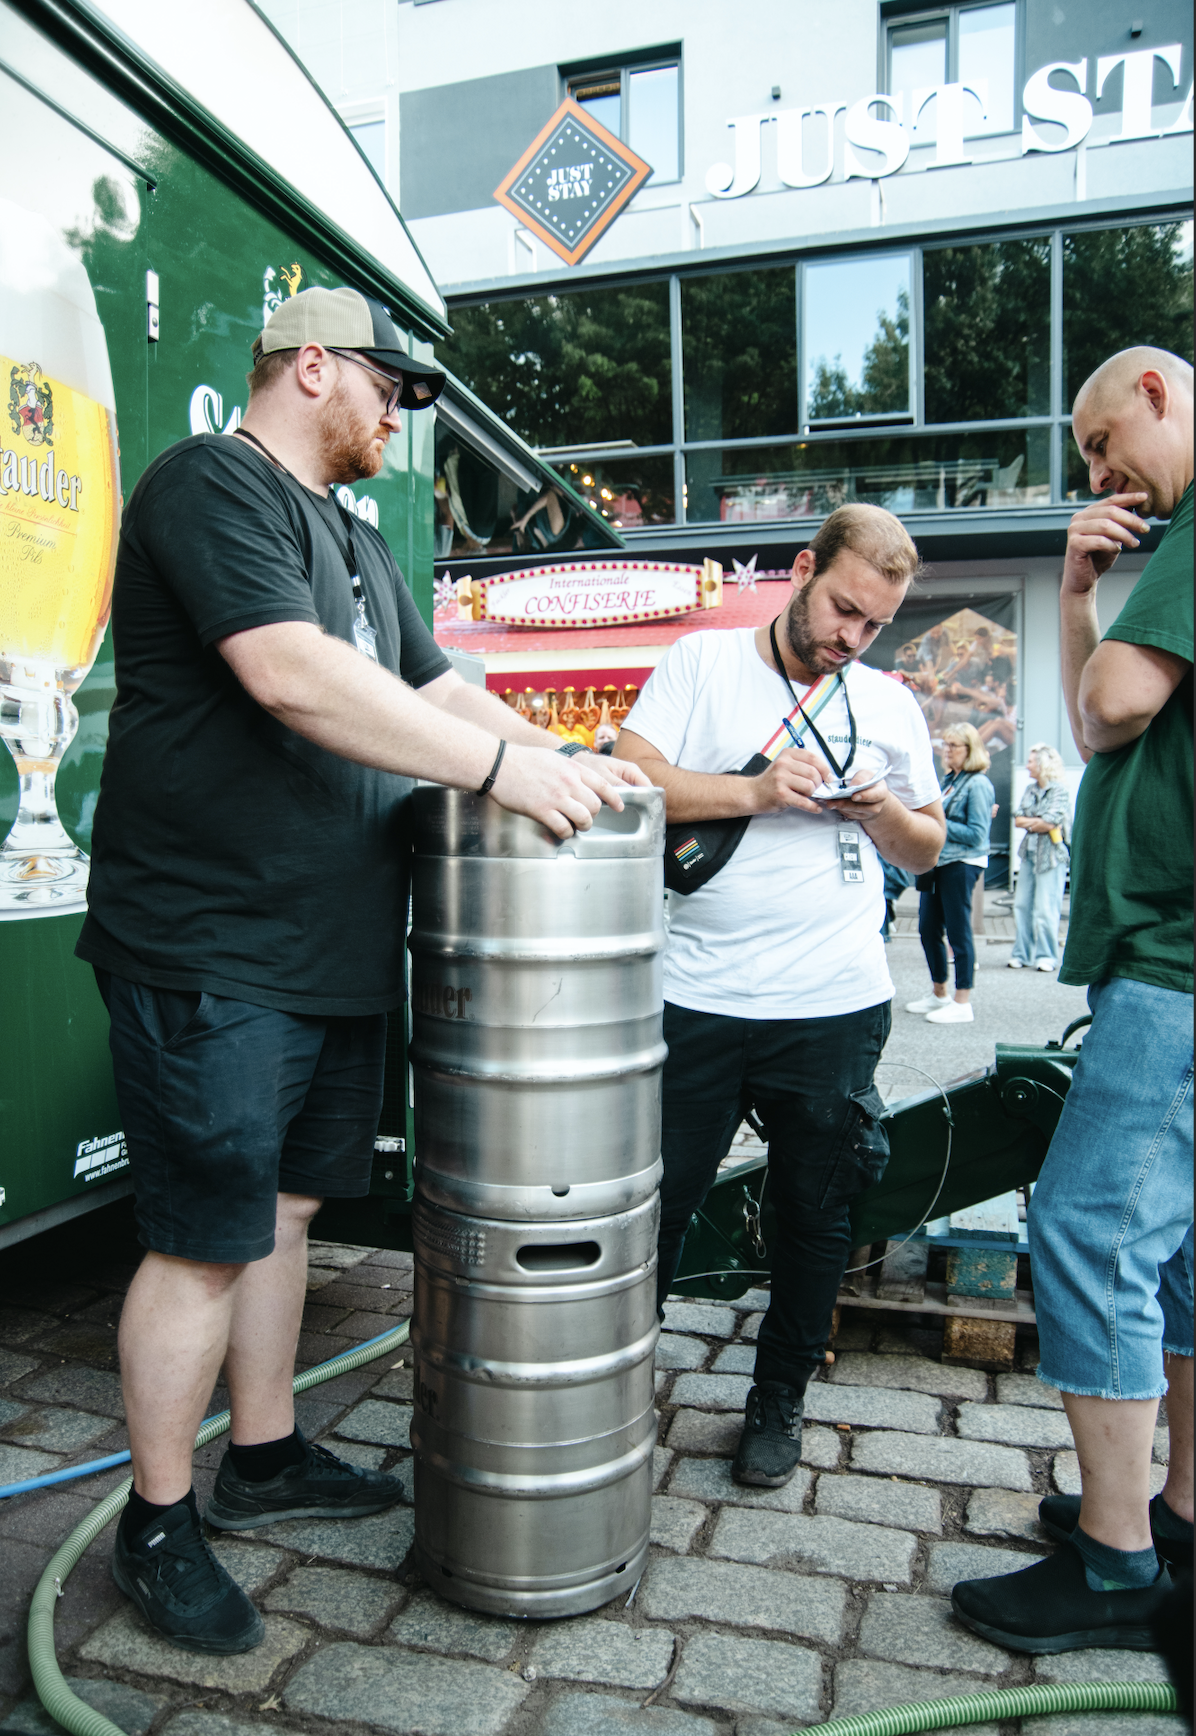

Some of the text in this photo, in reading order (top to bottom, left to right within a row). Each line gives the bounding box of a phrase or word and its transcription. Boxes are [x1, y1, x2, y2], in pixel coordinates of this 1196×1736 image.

[705, 81, 987, 199] JUST
[546, 162, 594, 186] JUST
[548, 179, 593, 202] STAY
[0, 447, 82, 512] auder
[6, 520, 57, 550] Premium
[20, 544, 44, 565] Pils
[549, 571, 630, 590] Internationale
[524, 589, 657, 615] CONFISERIE
